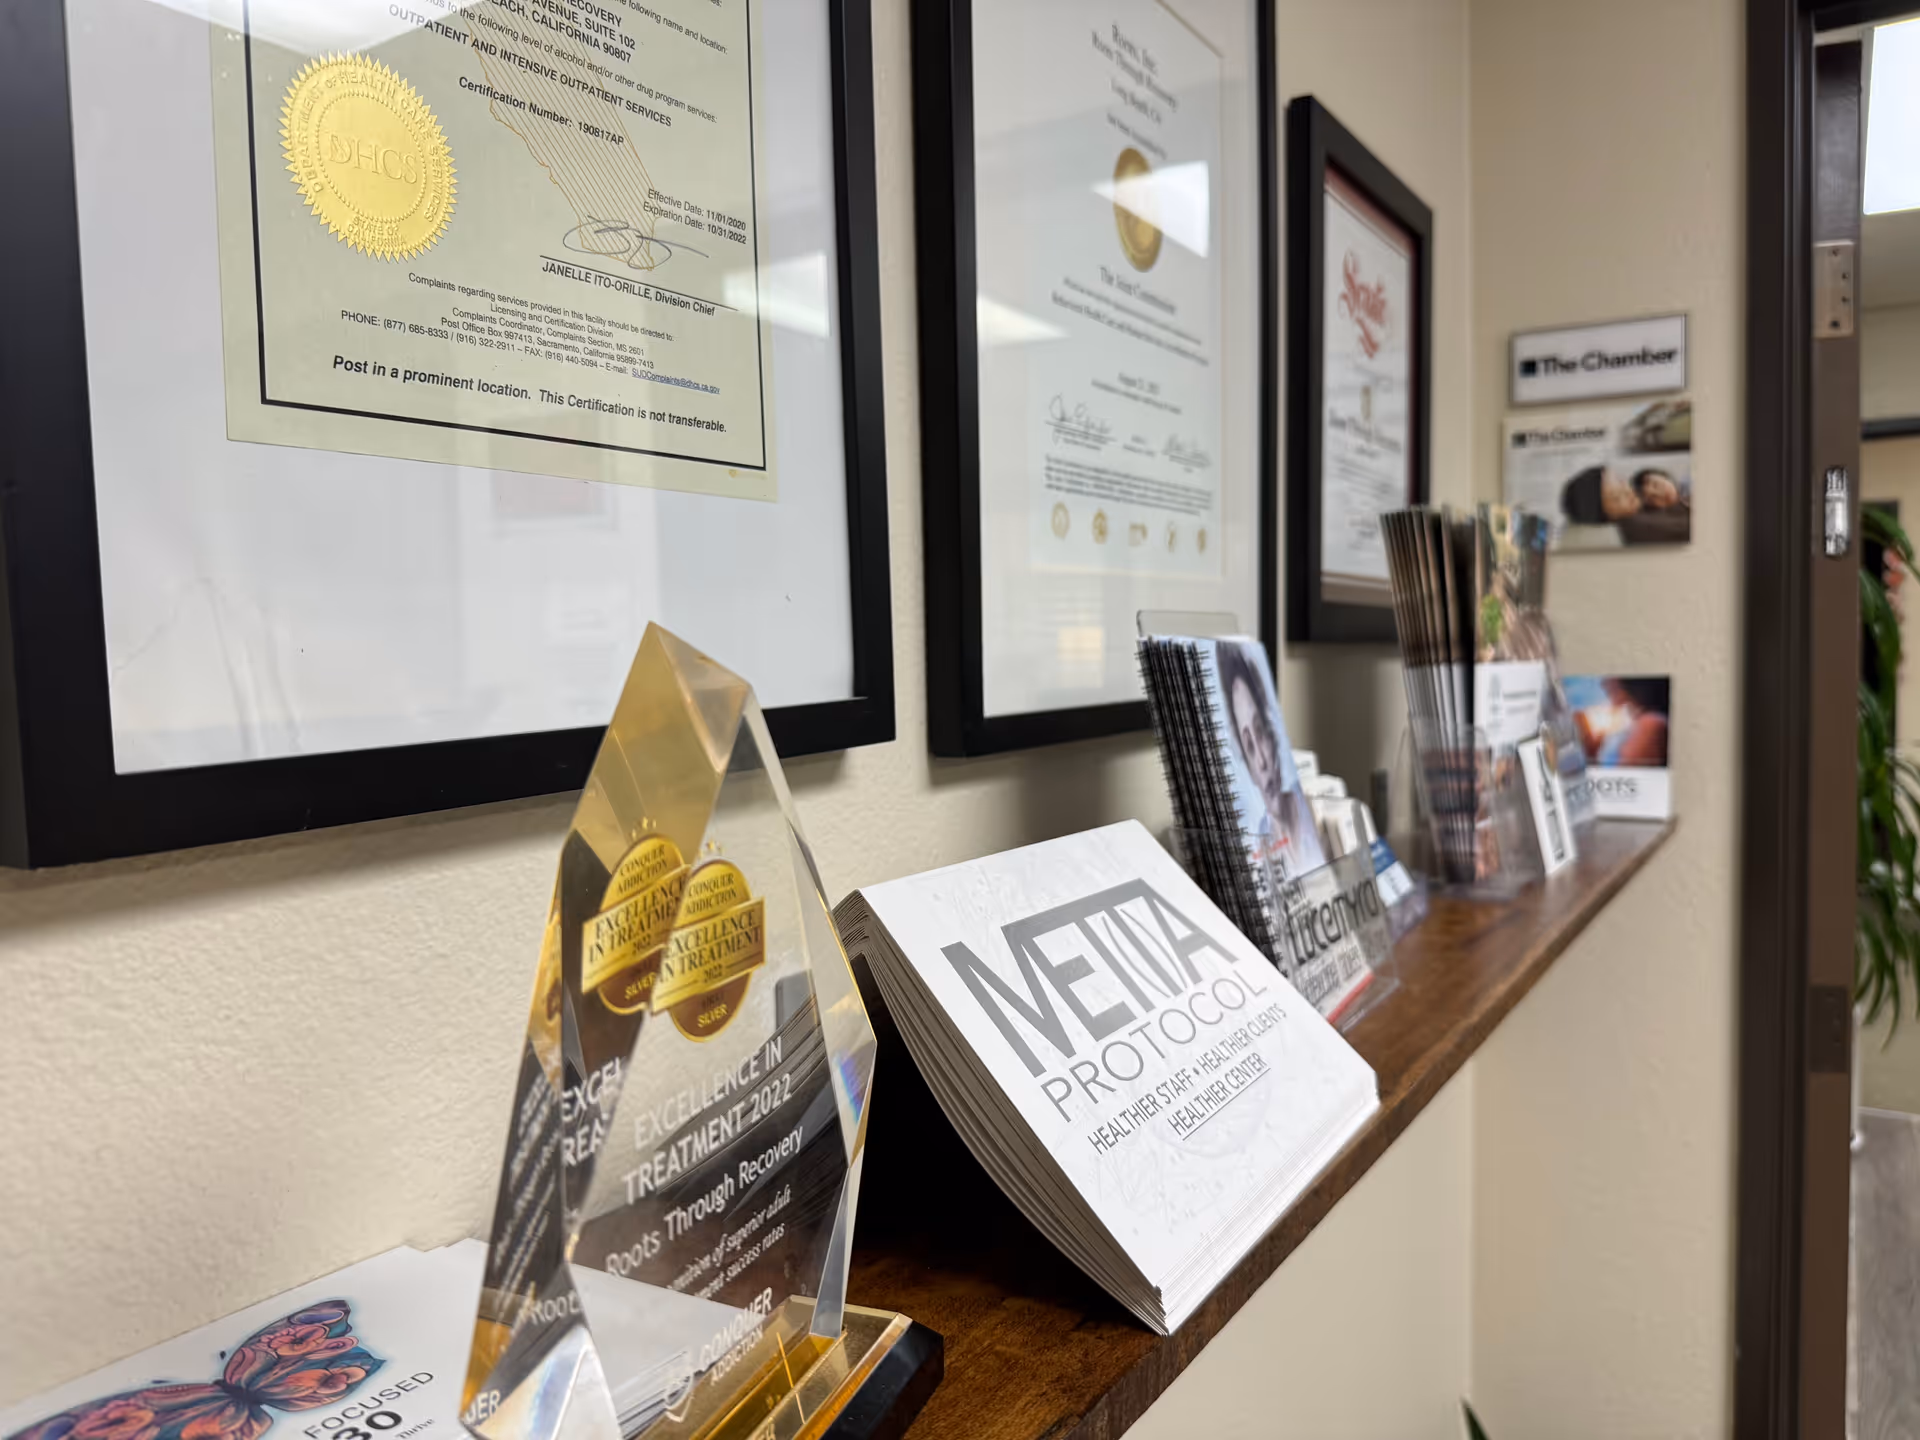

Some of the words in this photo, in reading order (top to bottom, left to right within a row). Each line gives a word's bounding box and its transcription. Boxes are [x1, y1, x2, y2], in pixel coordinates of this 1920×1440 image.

[532, 10, 600, 50] CALIFORNIA
[602, 42, 632, 63] 90807
[566, 0, 622, 27] ECOVERY
[584, 17, 616, 41] SUITE
[618, 33, 636, 50] 102
[628, 1, 661, 24] following
[663, 17, 683, 33] name
[685, 28, 699, 41] and
[700, 33, 728, 55] location:
[388, 4, 469, 45] OUTPATIENT
[471, 38, 497, 56] AND
[500, 48, 558, 81] INTENSIVE
[560, 73, 625, 107] OUTPATIENT
[625, 100, 672, 127] SERVICES
[448, 3, 457, 14] to
[460, 8, 475, 21] the
[478, 13, 519, 42] following
[522, 32, 542, 49] level
[544, 44, 554, 54] of
[555, 47, 585, 68] alcohol
[587, 61, 613, 79] and/or
[614, 73, 635, 88] other
[636, 82, 654, 98] drug
[655, 90, 686, 110] program
[687, 104, 717, 123] services:
[459, 76, 526, 110] Certification
[528, 102, 573, 128] Number:
[578, 121, 625, 146] 190817AP
[329, 134, 418, 184] DHCS
[643, 201, 683, 224] Expiration
[684, 216, 705, 231] Date:
[707, 223, 747, 244] 10/31/2022
[647, 188, 682, 209] Effective
[684, 201, 705, 217] Date:
[706, 209, 747, 231] 11/01/2020
[408, 272, 456, 292] Complaints
[458, 285, 496, 302] regarding
[497, 293, 529, 309] services
[530, 302, 562, 317] provided
[563, 307, 570, 317] in
[571, 309, 584, 320] this
[585, 312, 606, 327] facility
[607, 317, 629, 331] should
[630, 323, 639, 333] be
[640, 326, 665, 340] directed
[542, 262, 592, 284] JANELLE
[594, 275, 653, 301] ITO-ORILLE,
[655, 291, 691, 310] Division
[692, 301, 716, 316] Chief
[341, 310, 381, 326] PHONE:
[383, 319, 406, 333] (877)
[408, 324, 449, 339] 685-8333
[456, 332, 477, 346] (916)
[478, 338, 515, 352] 322-2911
[524, 346, 543, 357] FAX:
[545, 350, 563, 363] (916)
[565, 355, 598, 369] 440-5094
[605, 363, 628, 375] E-mail:
[441, 317, 460, 329] Post
[462, 321, 485, 334] Office
[487, 327, 502, 338] Box
[504, 330, 535, 345] 997413,
[537, 337, 582, 354] Sacramento,
[583, 347, 615, 361] California
[452, 307, 497, 324] Complaints
[499, 317, 545, 336] Coordinator,
[546, 328, 587, 344] Complaints
[588, 336, 615, 350] Section,
[616, 343, 627, 353] MS
[629, 345, 644, 356] 2601
[490, 303, 527, 321] Licensing
[528, 313, 543, 323] and
[544, 316, 586, 332] Certification
[587, 326, 614, 338] Division
[1541, 357, 1577, 374] The
[1581, 347, 1677, 371] Chamber
[333, 355, 368, 375] Post
[372, 362, 386, 376] in
[390, 367, 399, 378] a
[402, 368, 473, 391] prominent
[477, 379, 531, 400] location.
[539, 389, 565, 405] This
[567, 395, 634, 417] Certification
[637, 407, 647, 419] is
[649, 411, 666, 423] not
[668, 413, 727, 433] transferable.
[686, 888, 738, 915] ADDICTION
[688, 873, 735, 897] CONQUER
[680, 926, 762, 975] TREATMENT
[1040, 970, 1268, 1123] PROTOCOL
[634, 1050, 760, 1151] EXCELLENCE
[764, 1035, 783, 1071] IN
[1087, 1092, 1164, 1155] HEALTHIER
[1155, 1067, 1194, 1105] STAFF
[1195, 1026, 1254, 1075] HEALTHIER
[1247, 1002, 1288, 1038] CLIENTS
[1167, 1079, 1232, 1136] HEALTHIER
[1224, 1051, 1268, 1089] CENTER
[621, 1102, 747, 1205] TREATMENT
[751, 1072, 793, 1125] 2022
[604, 1230, 661, 1277] Roots
[664, 1173, 735, 1242] Through
[739, 1126, 804, 1189] Recovery
[700, 1286, 773, 1372] CONQUER
[711, 1325, 764, 1387] ADDICTION
[303, 1372, 434, 1439] FOCUSED
[395, 1418, 435, 1439] Thrive
